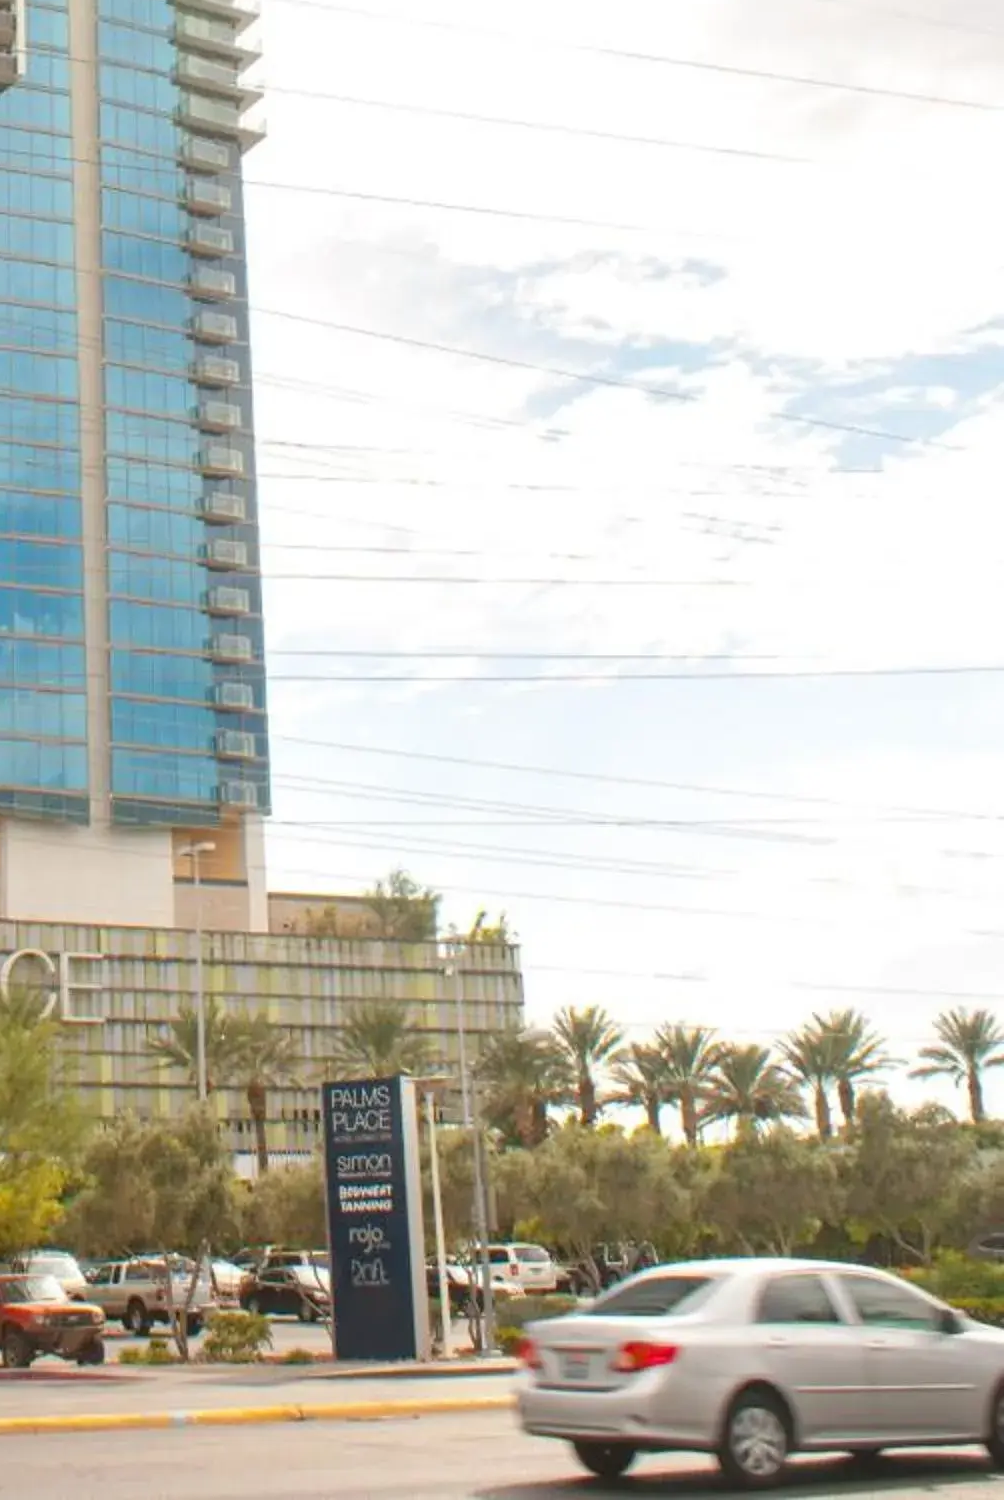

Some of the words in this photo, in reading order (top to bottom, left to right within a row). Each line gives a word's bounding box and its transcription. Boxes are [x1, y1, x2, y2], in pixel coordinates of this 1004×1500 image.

[331, 1085, 390, 1109] PALMS
[332, 1109, 391, 1132] PLACE
[340, 1199, 393, 1213] TANNING
[349, 1223, 384, 1253] rojo
